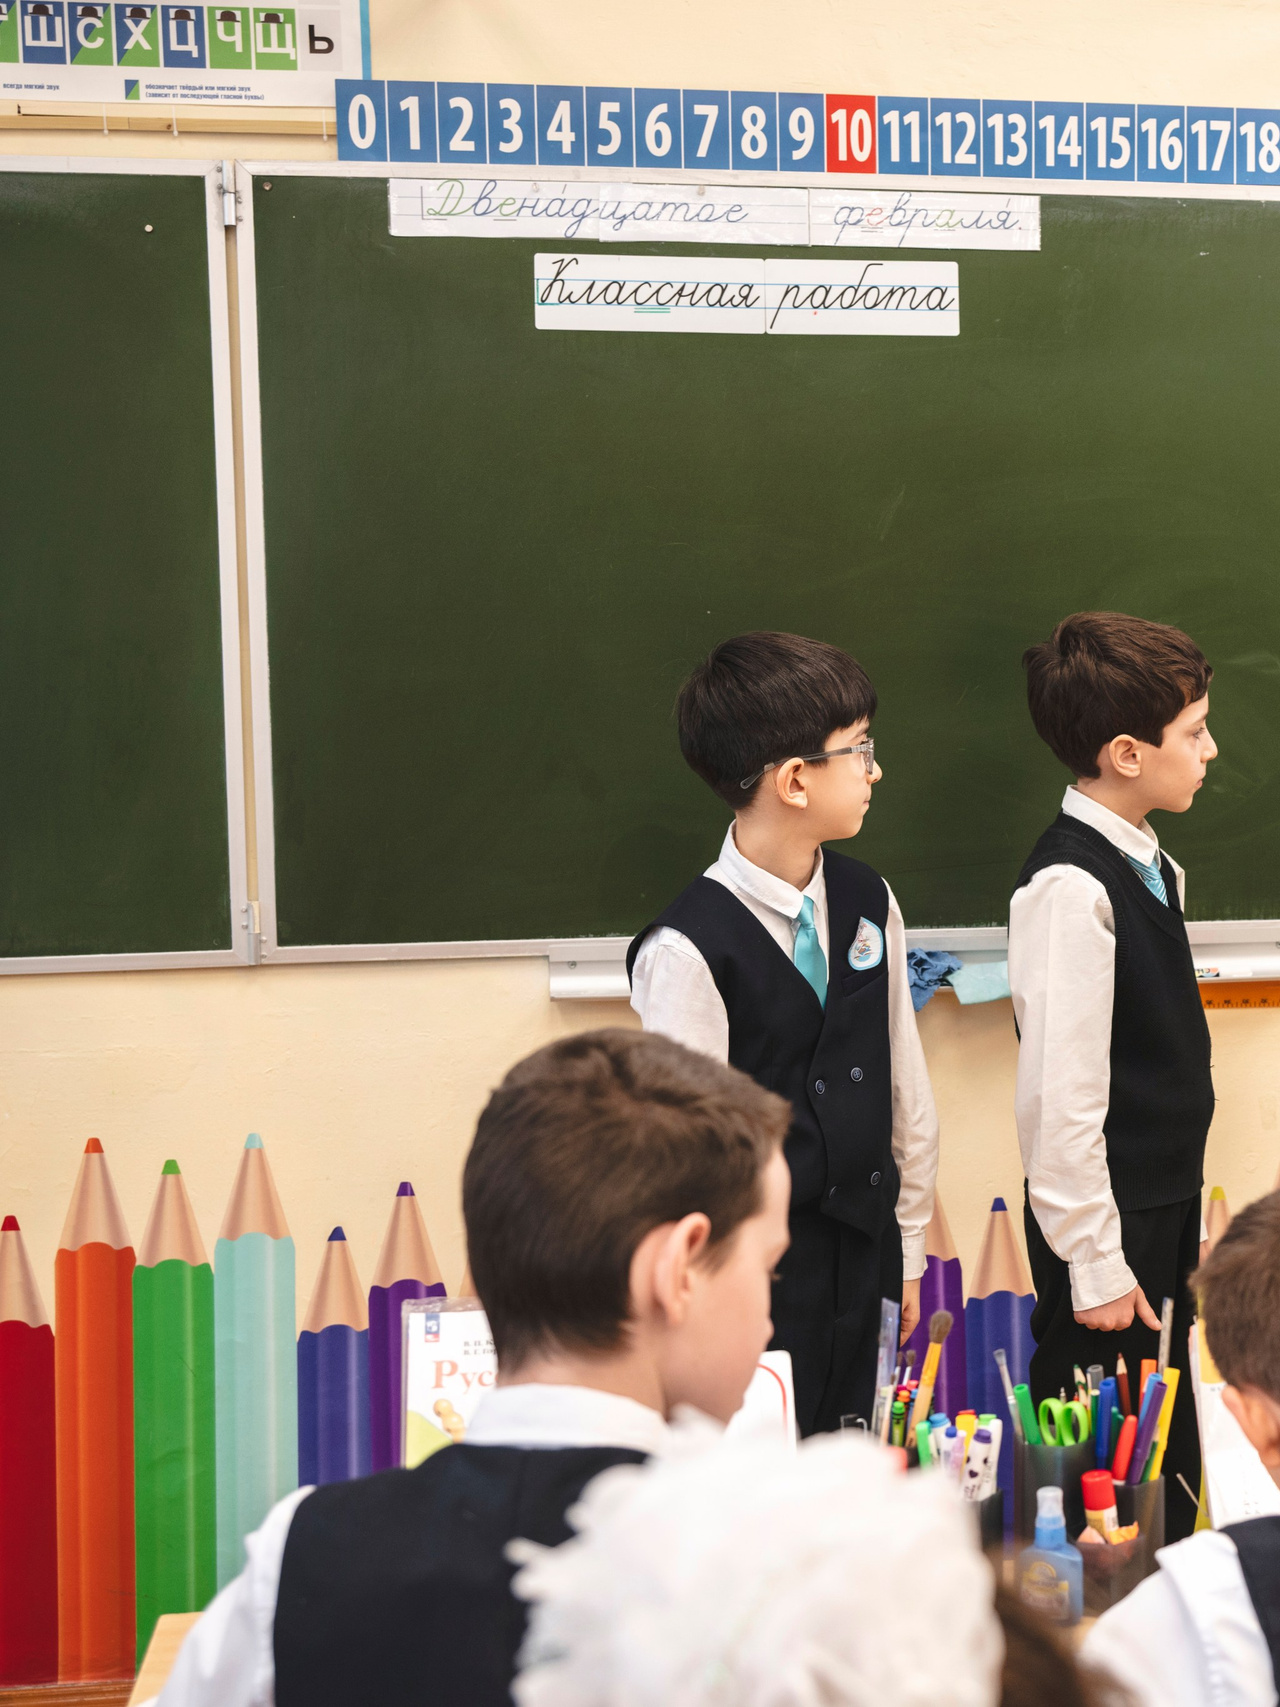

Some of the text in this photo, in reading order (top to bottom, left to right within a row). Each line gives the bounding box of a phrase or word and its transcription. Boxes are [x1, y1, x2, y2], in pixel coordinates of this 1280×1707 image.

[24, 15, 63, 47] Ш
[76, 17, 105, 49] С
[123, 18, 152, 50] Х
[169, 20, 198, 58] Ц
[216, 21, 243, 53] Ч
[255, 22, 296, 61] Щ
[348, 93, 377, 150] 0
[399, 96, 421, 151] 1
[448, 96, 476, 152] 2
[498, 98, 524, 154] 3
[546, 100, 576, 155] 4
[597, 101, 622, 156] 5
[644, 102, 673, 158] 6
[693, 104, 719, 158] 7
[740, 105, 768, 160] 8
[788, 106, 815, 161] 9
[830, 107, 873, 163] 10
[882, 109, 921, 164] 11
[934, 110, 977, 165] 12
[986, 112, 1029, 167] 13
[1038, 113, 1082, 168] 14
[1089, 116, 1131, 169] 15
[1140, 117, 1182, 171] 16
[1190, 118, 1232, 172] 17
[539, 256, 956, 330] Классная работа
